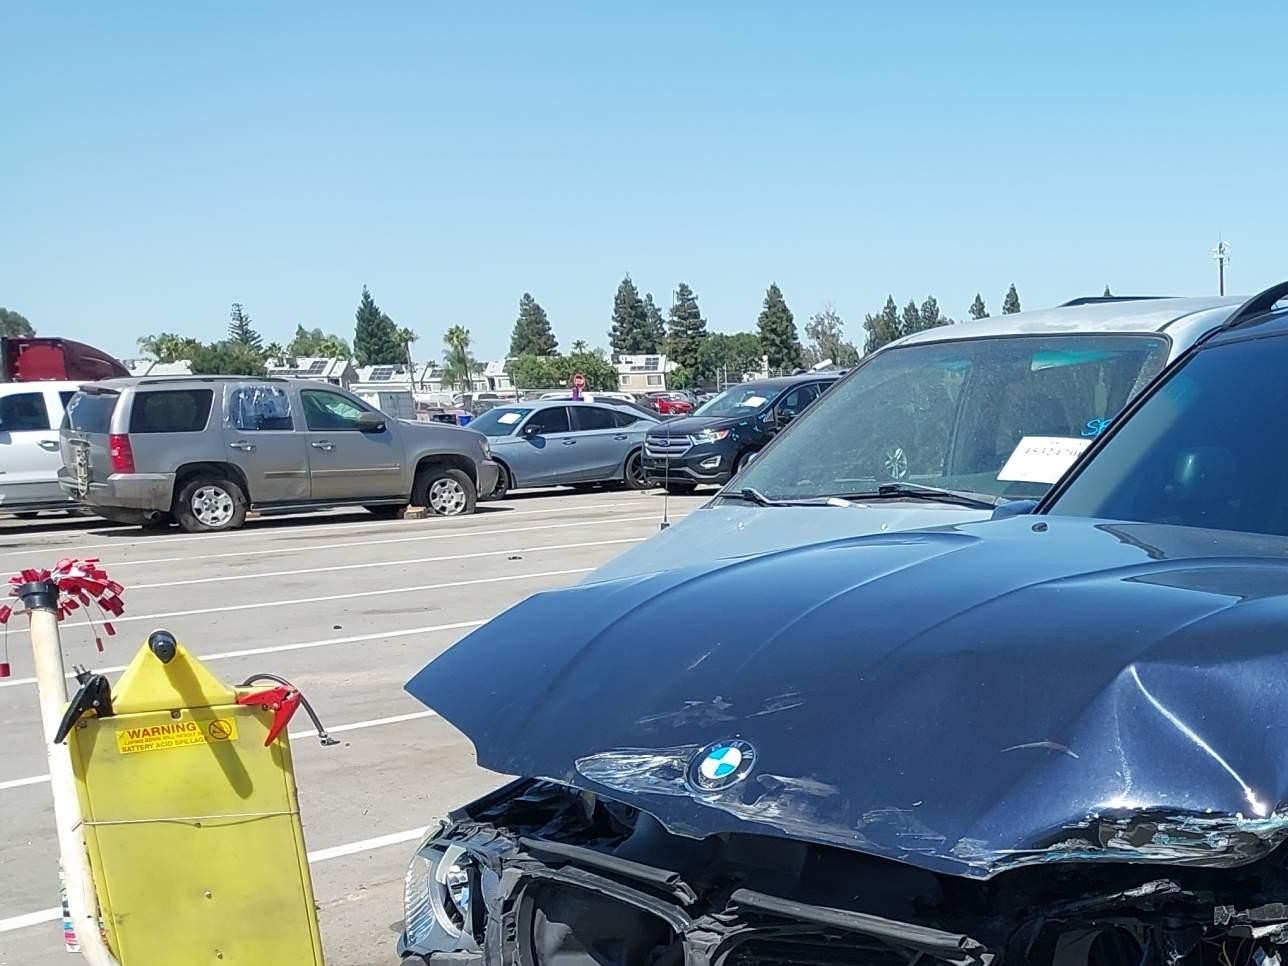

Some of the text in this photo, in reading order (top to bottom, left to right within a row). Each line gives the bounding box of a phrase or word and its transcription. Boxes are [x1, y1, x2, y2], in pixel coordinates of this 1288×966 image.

[127, 722, 197, 739] WARNING
[122, 743, 154, 752] BATTERY
[156, 740, 173, 749] ACID
